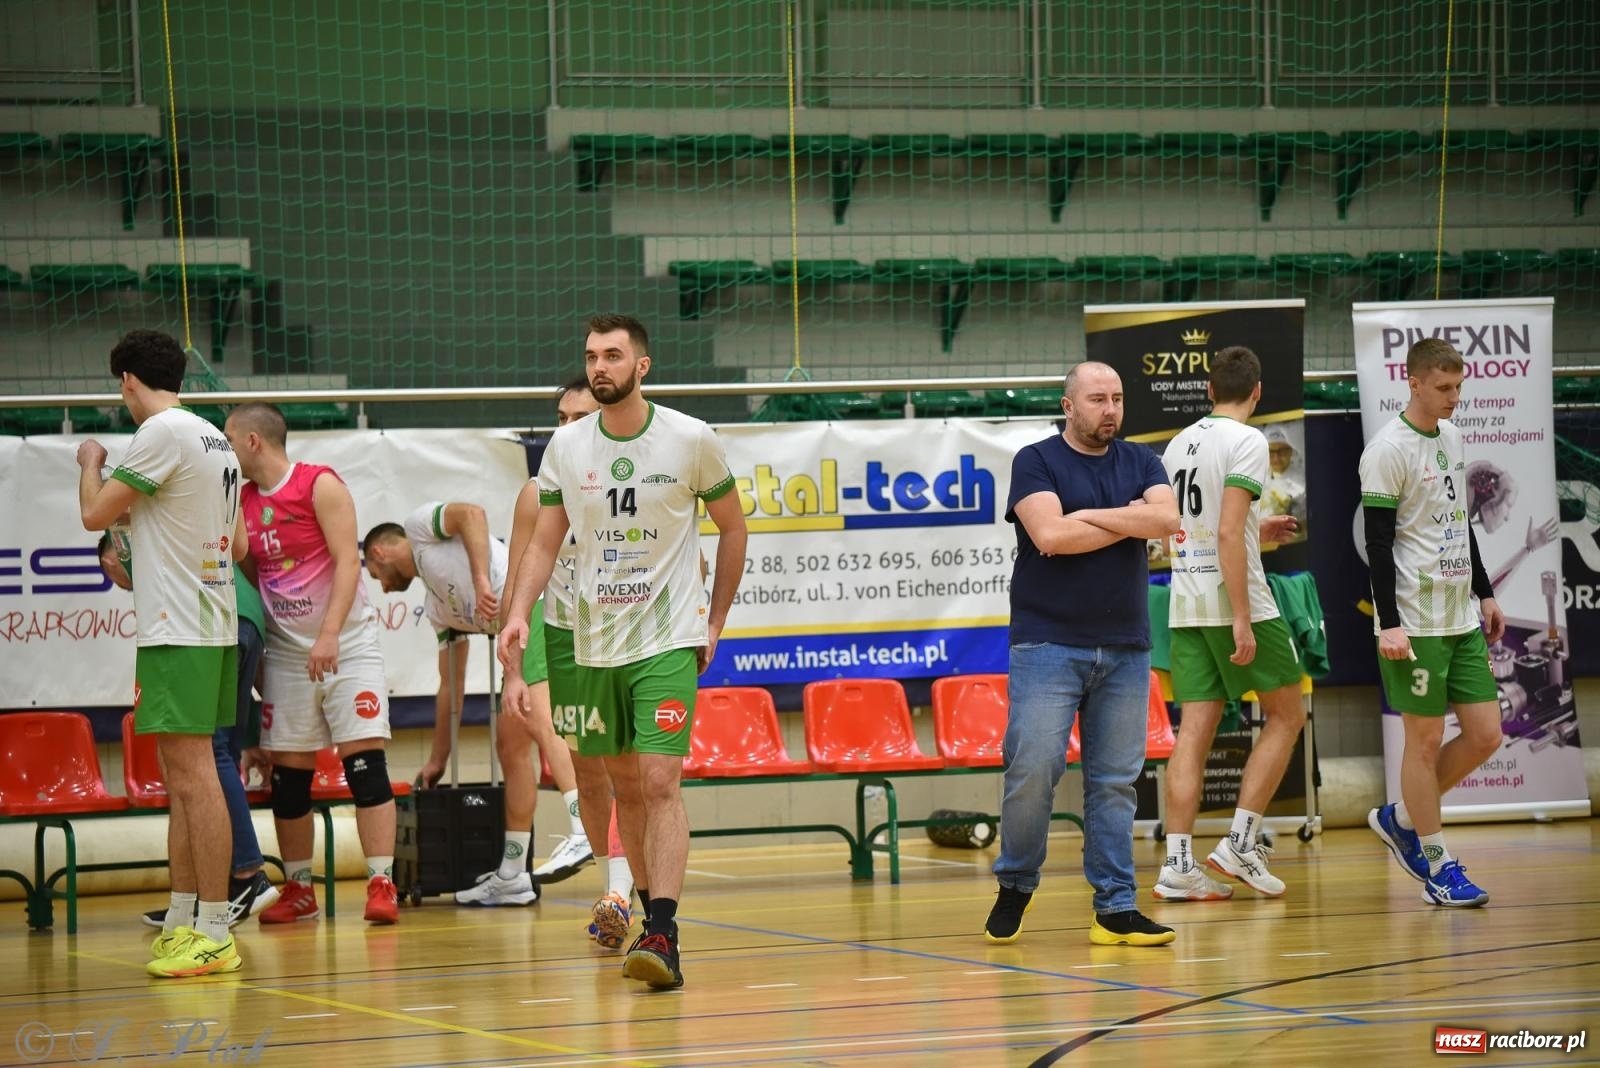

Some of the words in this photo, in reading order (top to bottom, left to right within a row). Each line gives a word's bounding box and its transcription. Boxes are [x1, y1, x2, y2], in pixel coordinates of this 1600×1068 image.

[1385, 359, 1531, 380] TELOGY
[1380, 400, 1402, 412] Nie
[1473, 397, 1516, 410] tempa
[1490, 417, 1505, 426] za
[1173, 467, 1203, 518] 16
[1444, 475, 1456, 501] 3
[606, 487, 637, 518] 14
[260, 529, 282, 555] 15
[594, 528, 658, 542] VISON
[762, 556, 786, 574] 88,
[796, 555, 830, 573] 502
[838, 553, 872, 571] 632
[880, 552, 920, 570] 695,
[932, 548, 964, 567] 606
[969, 547, 1003, 566] 363
[597, 582, 652, 596] PIVEXIN
[597, 594, 650, 604] TECHNOLOGY
[807, 583, 830, 601] ul.
[837, 582, 849, 601] J.
[854, 585, 890, 599] von
[734, 639, 948, 671] www.instal-tech.pl
[1411, 668, 1429, 696] 3
